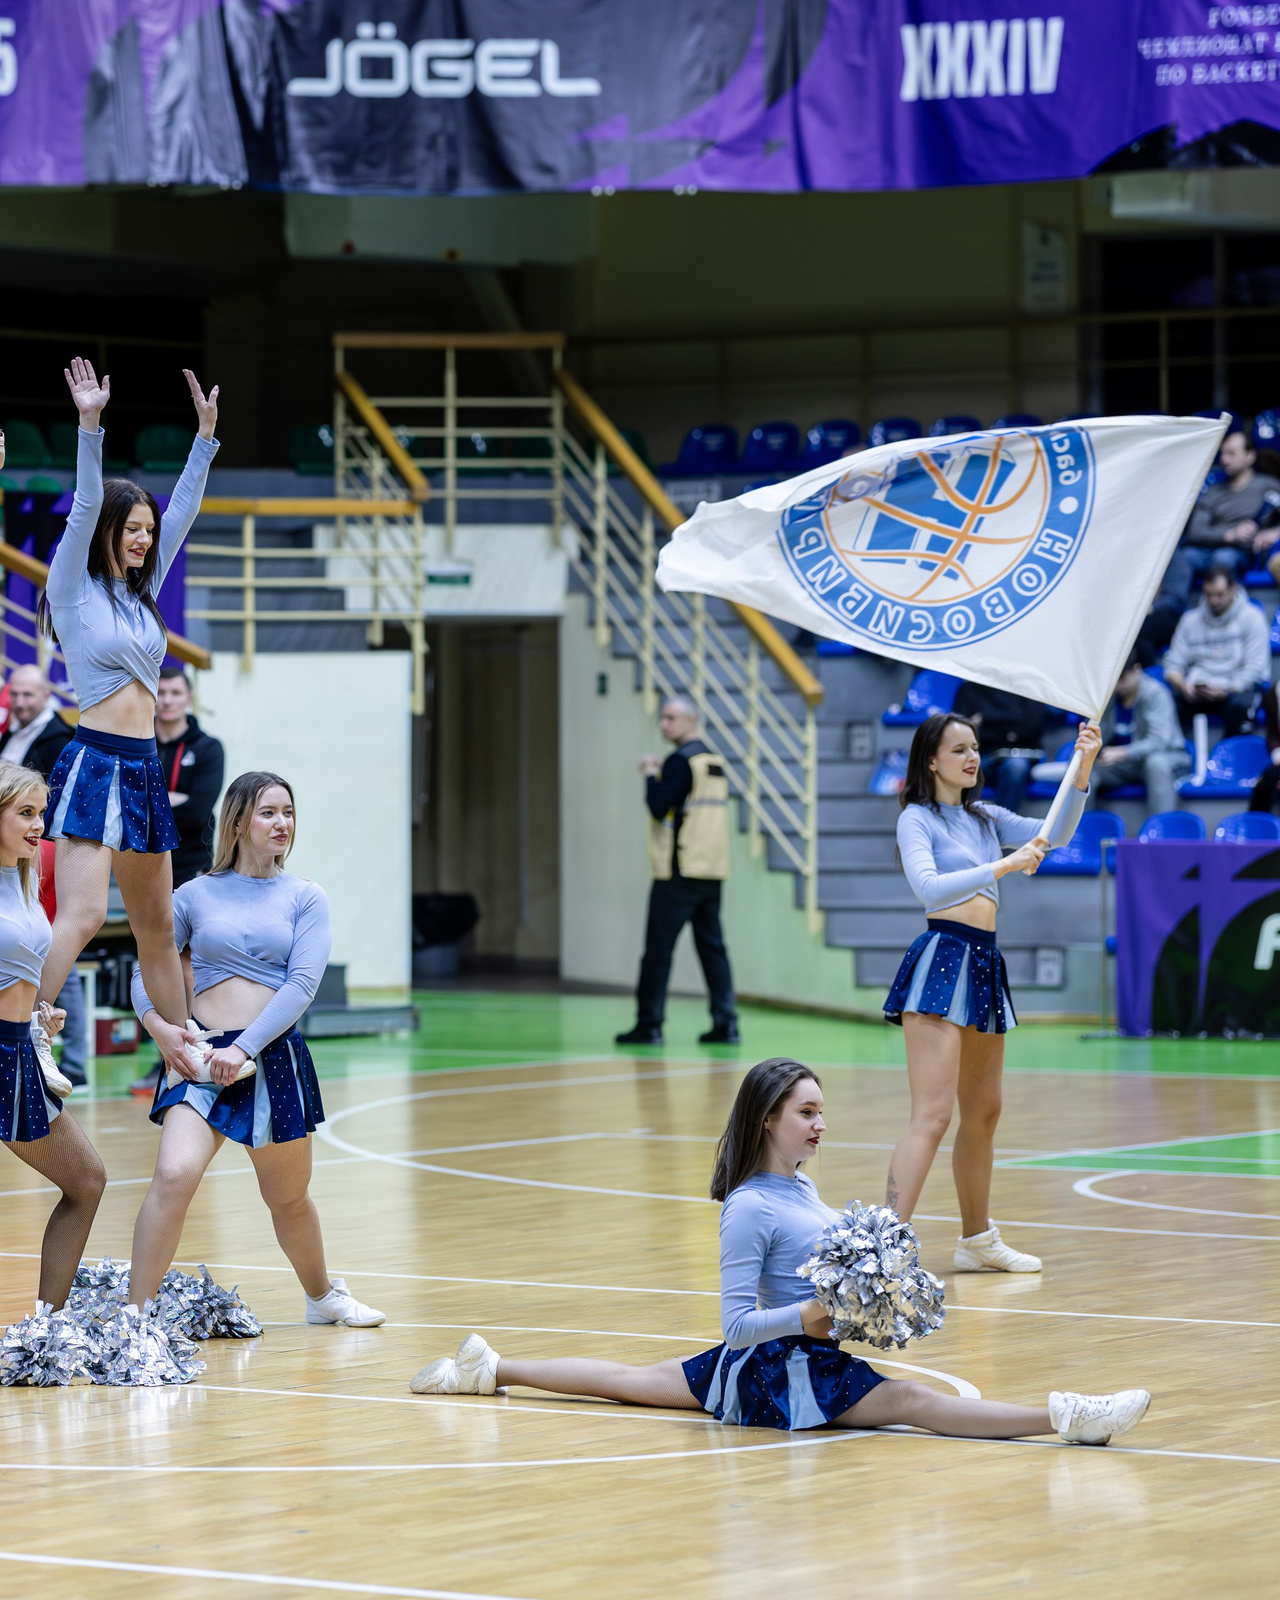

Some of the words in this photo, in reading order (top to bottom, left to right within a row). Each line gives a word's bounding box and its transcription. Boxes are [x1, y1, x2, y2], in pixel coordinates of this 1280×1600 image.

[286, 21, 603, 98] JÖGEL
[899, 16, 1065, 102] XXXIV
[1191, 59, 1280, 85] БАСКЕТ
